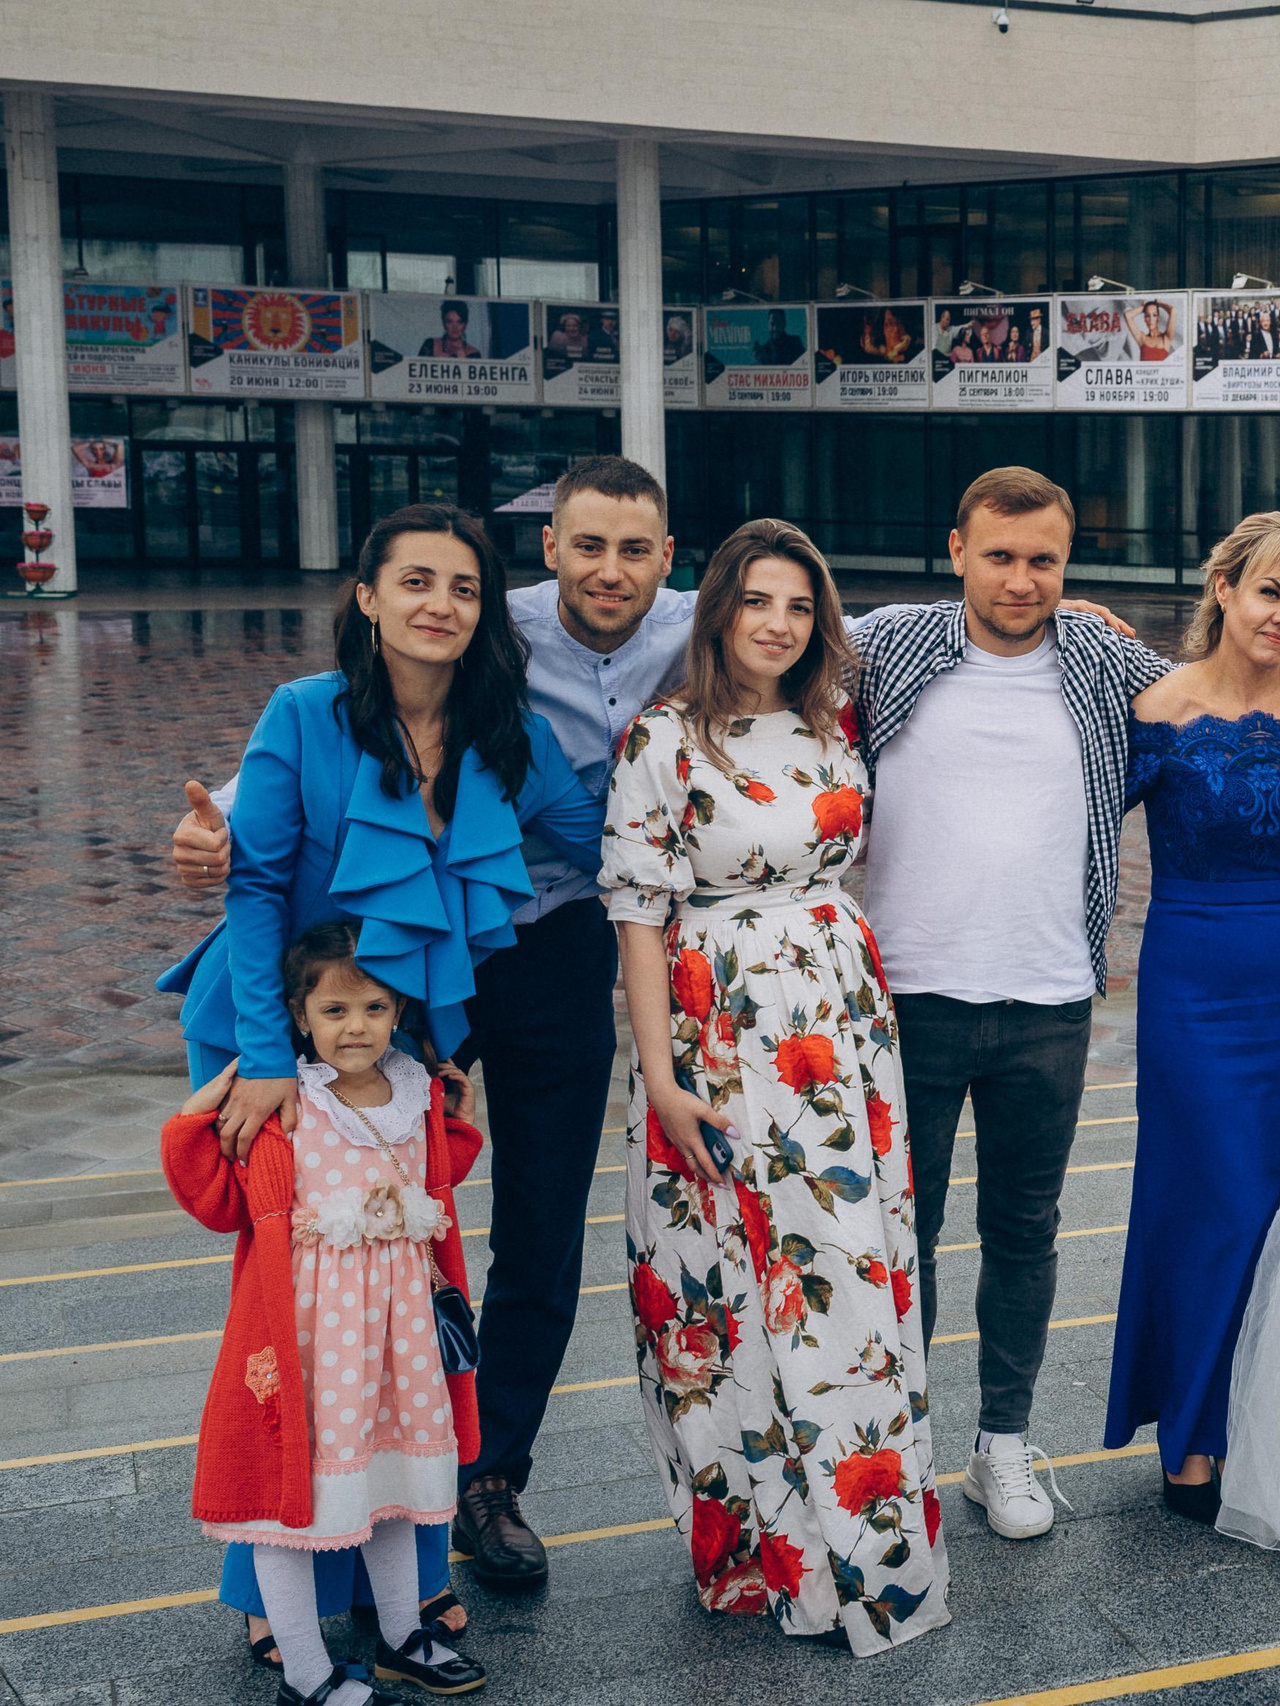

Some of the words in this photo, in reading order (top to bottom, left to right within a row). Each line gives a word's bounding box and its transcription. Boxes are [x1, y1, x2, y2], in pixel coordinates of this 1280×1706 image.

[64, 294, 146, 312] ЬТУРНЫЕ
[66, 315, 142, 332] НИКУЛЫ
[229, 354, 290, 367] КАНИКУЛЫ
[294, 356, 360, 370] БОНИФАЦИЯ
[408, 363, 461, 379] ЕЛЕНА
[468, 365, 528, 381] ВАЕНГА
[728, 374, 751, 387] СТАС
[754, 370, 809, 387] МИХАЙЛОВ
[840, 370, 870, 383] ИГОРЬ
[872, 370, 926, 383] КОРНЕЛЮК
[959, 369, 1028, 383] ПИГМАЛИОН
[1085, 368, 1133, 386] СЛАВА
[1222, 366, 1273, 379] ВЛАДИМИР
[230, 376, 243, 386] 20
[247, 376, 279, 387] ИЮНЯ
[288, 378, 319, 388] 12:00
[408, 383, 422, 393] 23
[425, 384, 458, 394] ИЮНЯ
[467, 385, 497, 396] 19:00
[578, 387, 588, 395] 24
[590, 387, 614, 396] ИЮНЯ
[729, 391, 736, 401] 15
[771, 391, 791, 401] 19:00
[877, 386, 898, 396] 19:00
[959, 387, 967, 397] 25
[1085, 390, 1096, 402] 19
[1099, 390, 1135, 402] НОЯБРЯ
[1143, 390, 1169, 402] 19:00
[1231, 393, 1257, 402] ДЕКАБРЯ
[86, 480, 122, 488] СЛАВЫ
